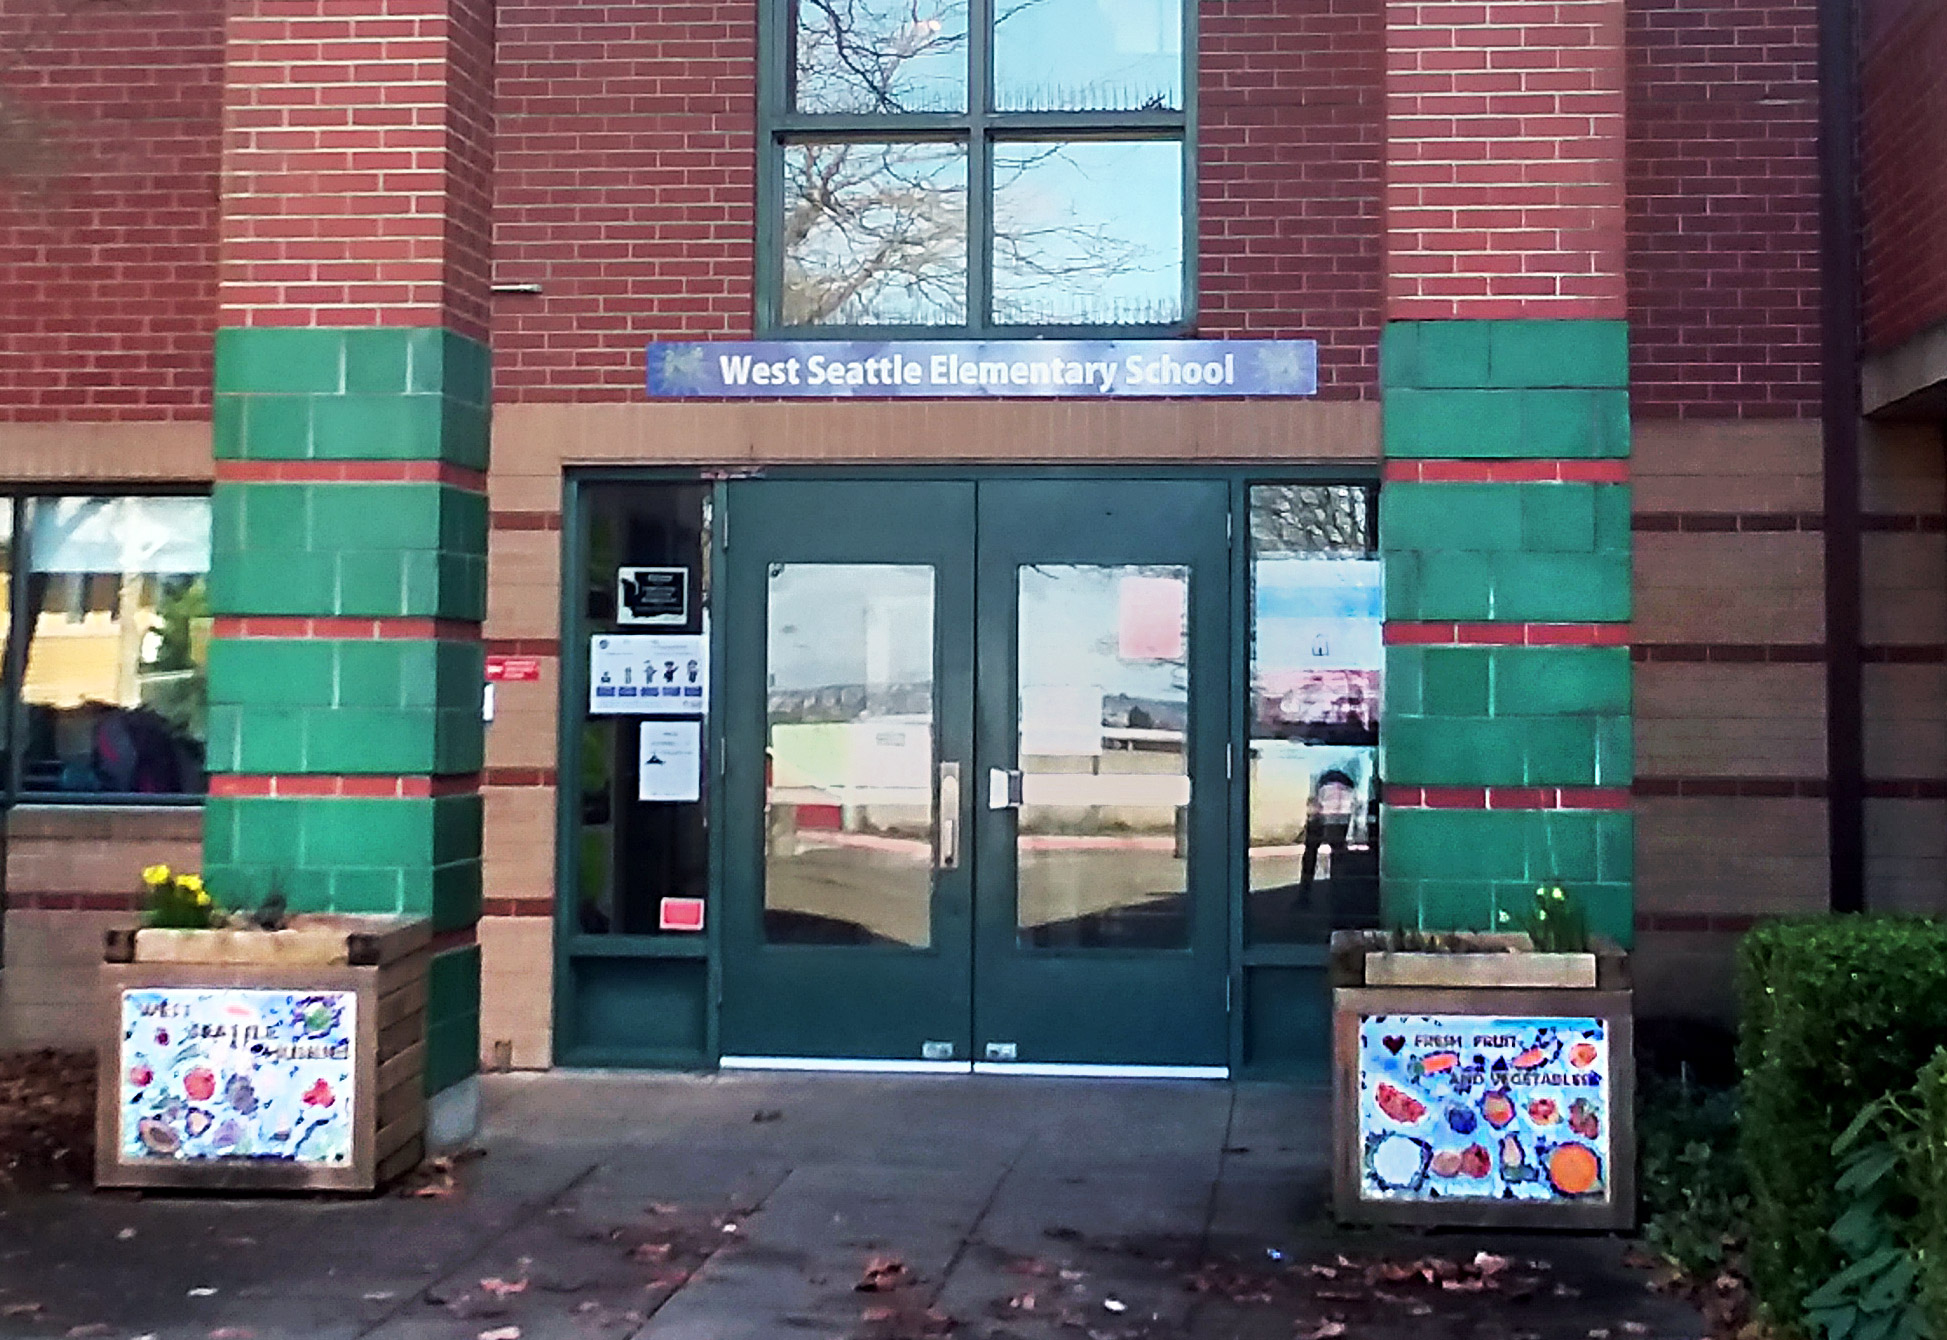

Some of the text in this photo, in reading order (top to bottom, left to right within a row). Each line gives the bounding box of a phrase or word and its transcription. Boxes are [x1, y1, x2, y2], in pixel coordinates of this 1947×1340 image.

[720, 354, 1234, 394] West Seattle Elementary School
[1414, 1034, 1516, 1048] FRESH FRUIT
[1449, 1072, 1485, 1086] AND
